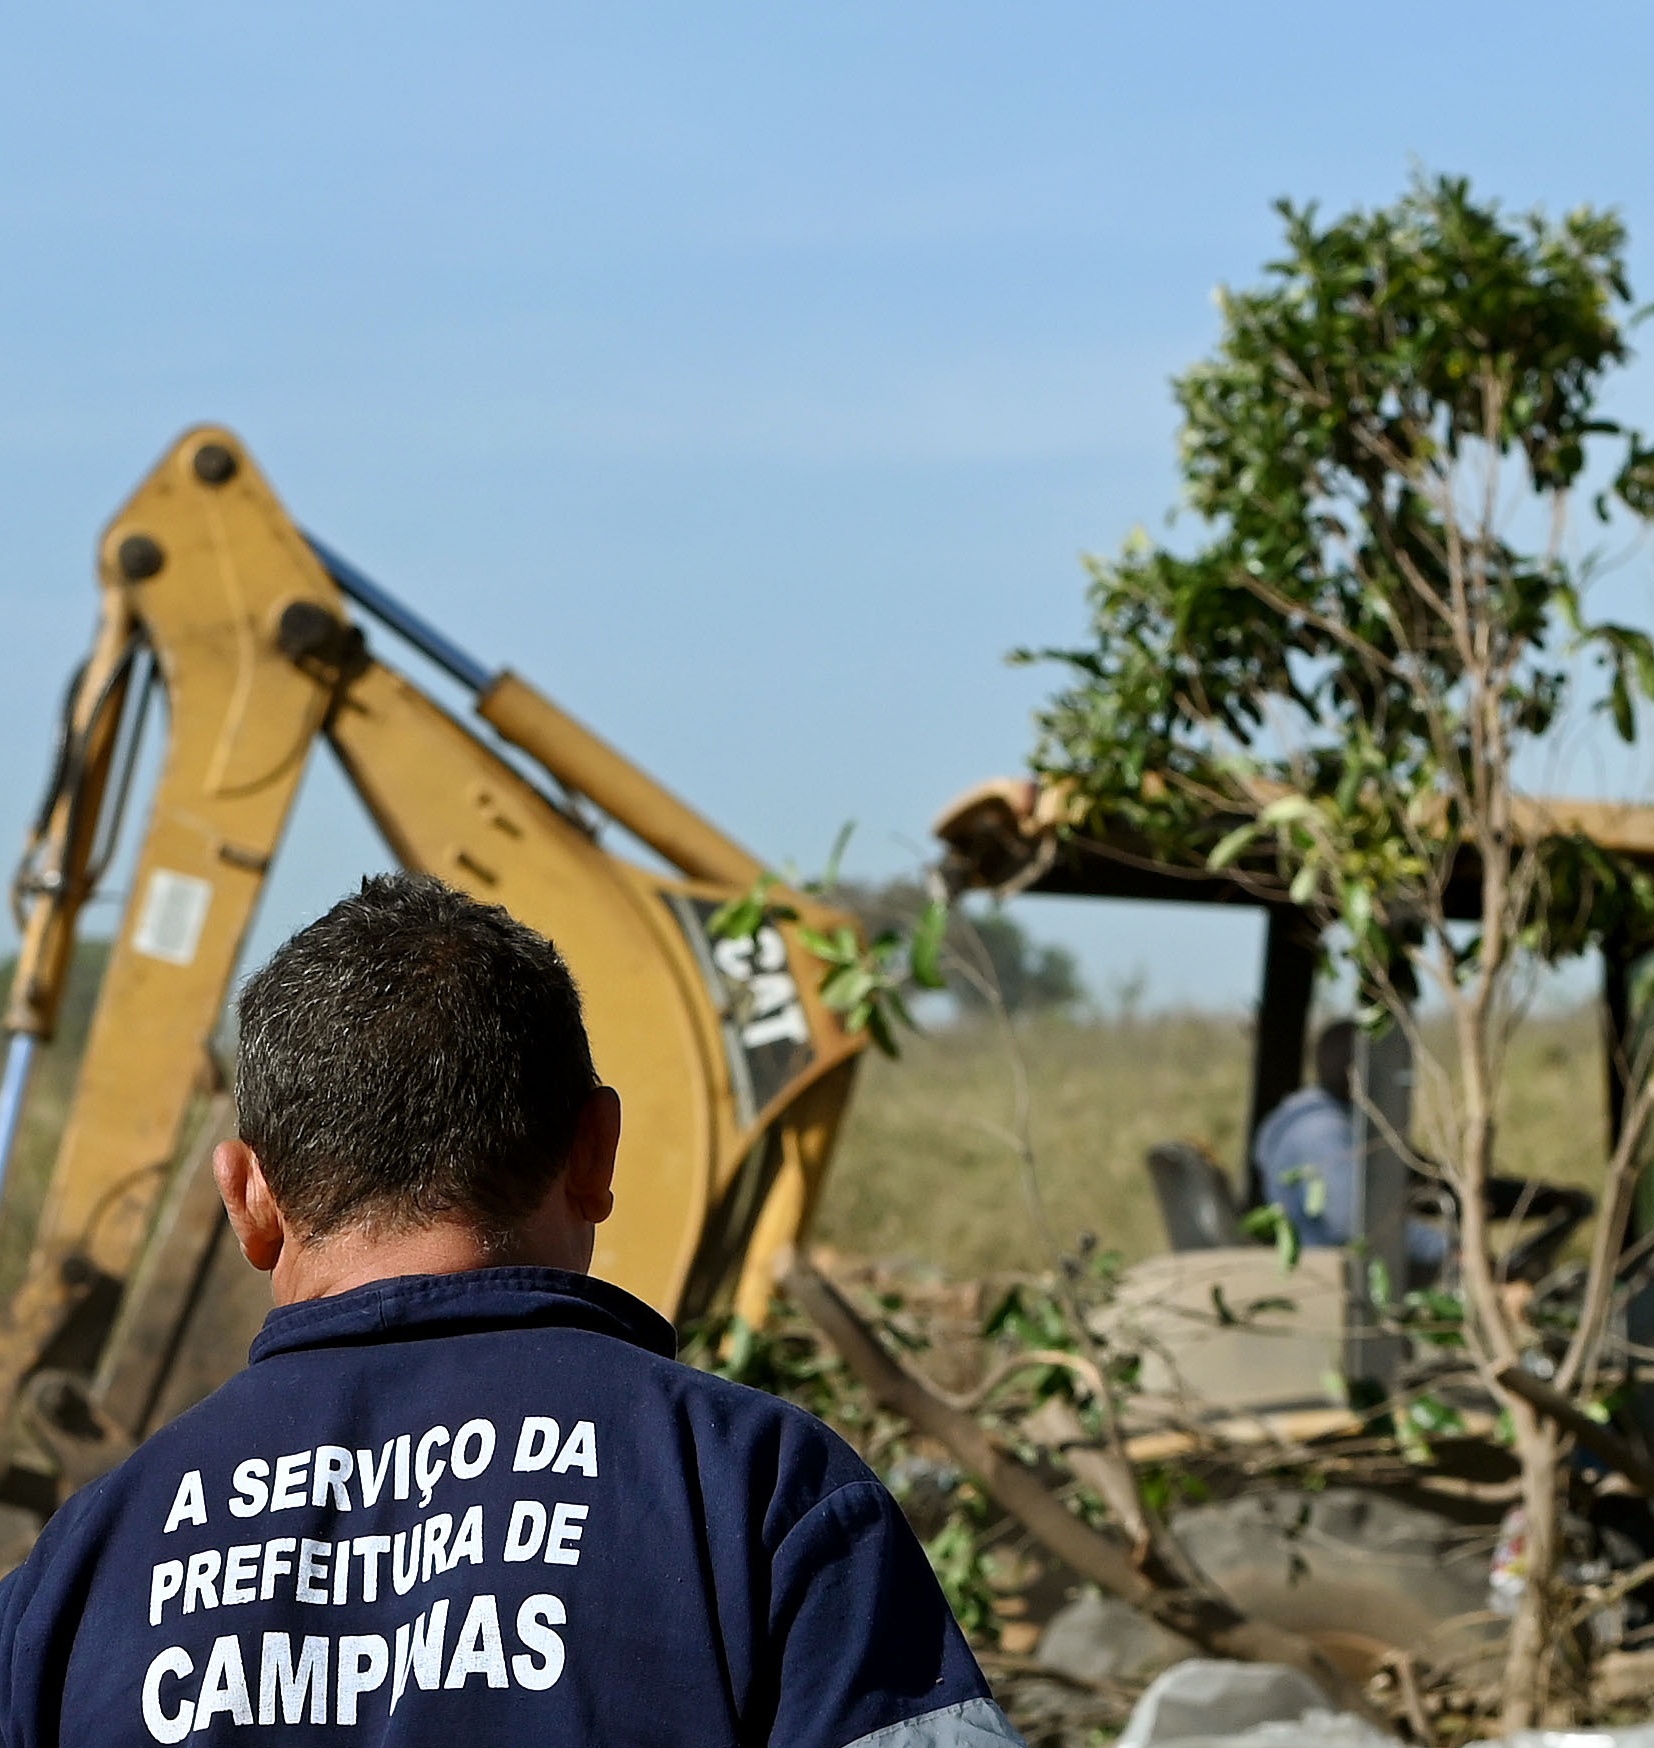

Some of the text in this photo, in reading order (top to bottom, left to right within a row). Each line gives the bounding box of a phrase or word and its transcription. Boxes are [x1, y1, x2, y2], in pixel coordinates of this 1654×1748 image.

[712, 923, 809, 1050] CAT
[163, 1416, 598, 1534] A SERVIÇO DA
[149, 1500, 590, 1627] PREFEITURA DE
[141, 1593, 567, 1745] CAMPINAS
